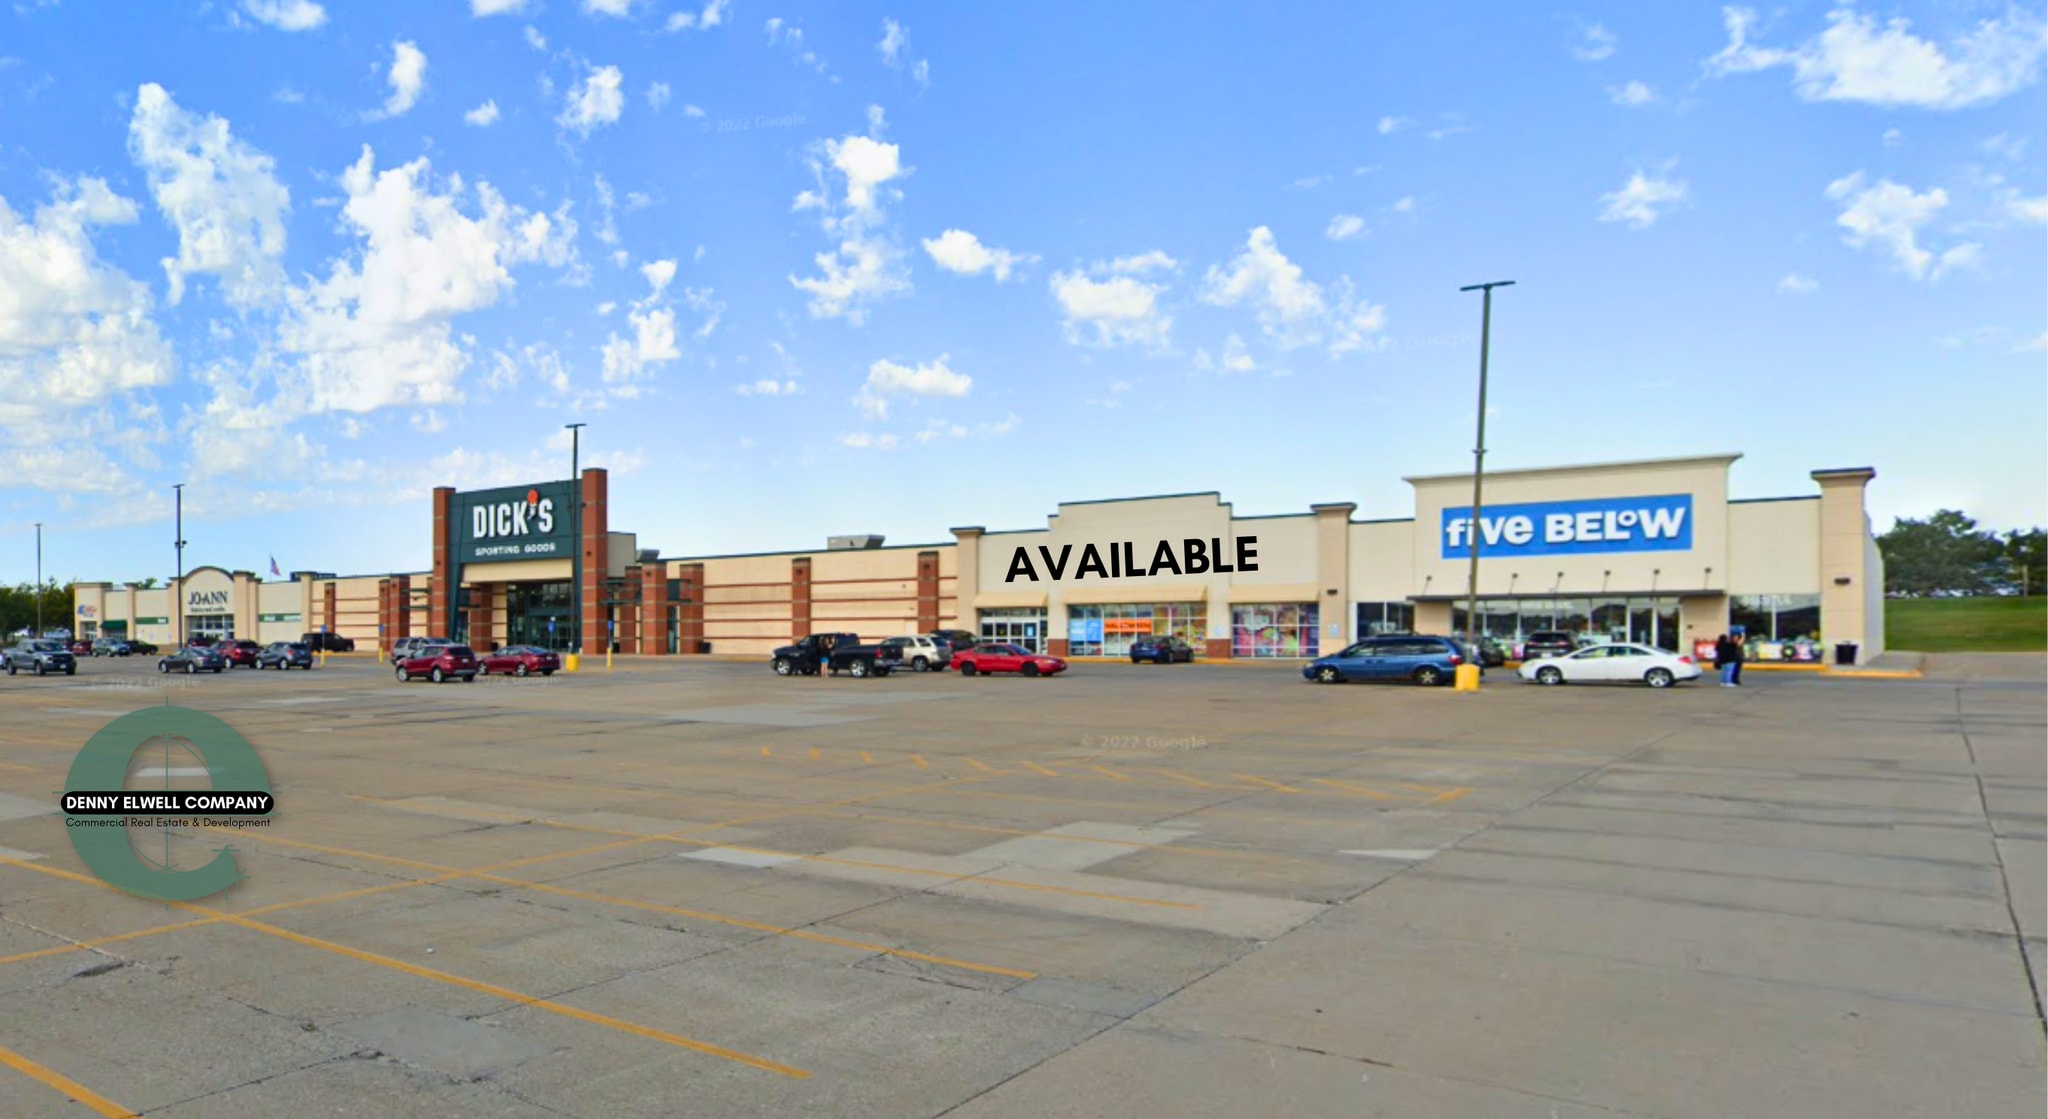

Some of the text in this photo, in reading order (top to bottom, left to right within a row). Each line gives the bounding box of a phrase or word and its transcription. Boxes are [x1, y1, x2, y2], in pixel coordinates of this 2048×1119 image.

[473, 491, 554, 539] DICK'S
[1446, 506, 1687, 547] five BELOW
[475, 542, 556, 557] SPORTING GOODS
